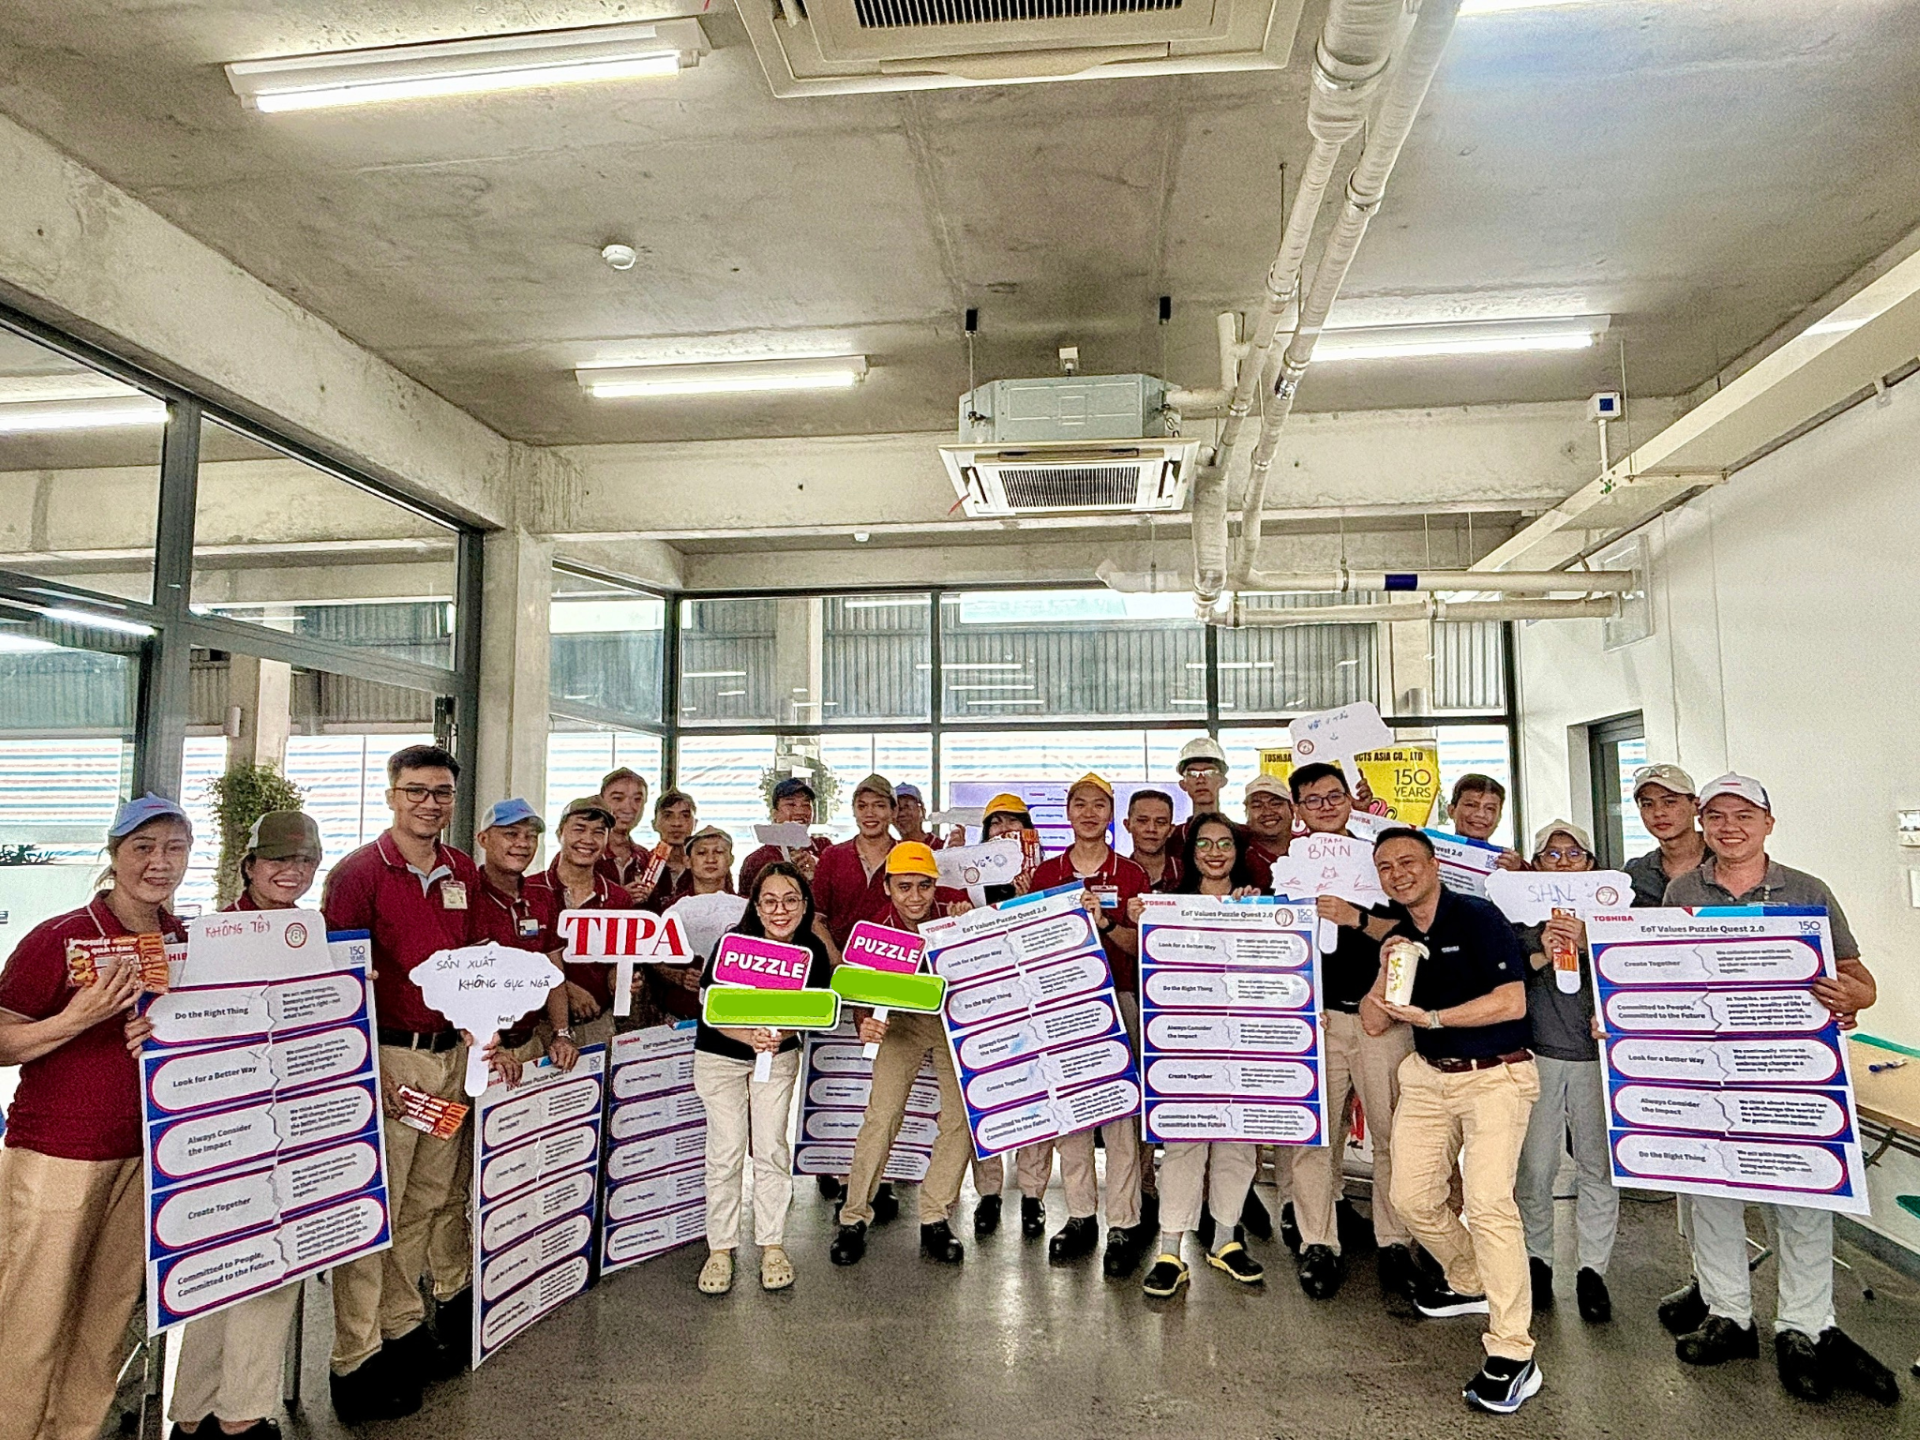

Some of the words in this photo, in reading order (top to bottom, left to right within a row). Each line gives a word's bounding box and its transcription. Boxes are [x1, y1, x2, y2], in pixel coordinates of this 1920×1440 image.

[1374, 752, 1391, 761] ASIA
[1393, 752, 1408, 761] CO.,
[1410, 752, 1423, 761] LTD
[1394, 769, 1431, 785] 150
[1394, 787, 1431, 797] YEARS
[1308, 844, 1351, 860] BNN
[925, 921, 957, 934] TOSHIBA
[974, 920, 996, 932] Values
[996, 914, 1017, 925] Puzzle
[1018, 908, 1037, 919] Quest
[1799, 921, 1820, 930] 150
[206, 920, 243, 938] KHÔNG
[566, 917, 687, 956] TIPA
[1720, 925, 1748, 934] Quest
[350, 946, 366, 955] 150
[854, 935, 919, 964] PUZZLE
[467, 951, 497, 969] XUẤT
[724, 951, 805, 979] PUZZLE
[458, 974, 497, 991] KHÔNG
[504, 979, 524, 991] GỤC
[530, 975, 550, 988] NGÃ
[204, 1009, 226, 1018] Right
[227, 1007, 249, 1015] Thing
[173, 1078, 193, 1088] Look
[195, 1075, 207, 1085] for
[214, 1069, 240, 1080] Better
[241, 1066, 257, 1076] Way
[188, 1132, 217, 1146] Always
[217, 1124, 252, 1137] Consider
[188, 1147, 202, 1156] the
[203, 1140, 232, 1152] Impact
[1663, 1152, 1684, 1160] Right
[1684, 1154, 1706, 1162] Thing
[188, 1206, 214, 1219] Create
[216, 1198, 251, 1212] Together
[177, 1263, 223, 1285] Committed
[225, 1260, 233, 1268] to
[234, 1253, 264, 1266] People,
[178, 1274, 223, 1297] Committed
[225, 1272, 234, 1280] to
[235, 1268, 248, 1277] the
[250, 1259, 275, 1273] Future
